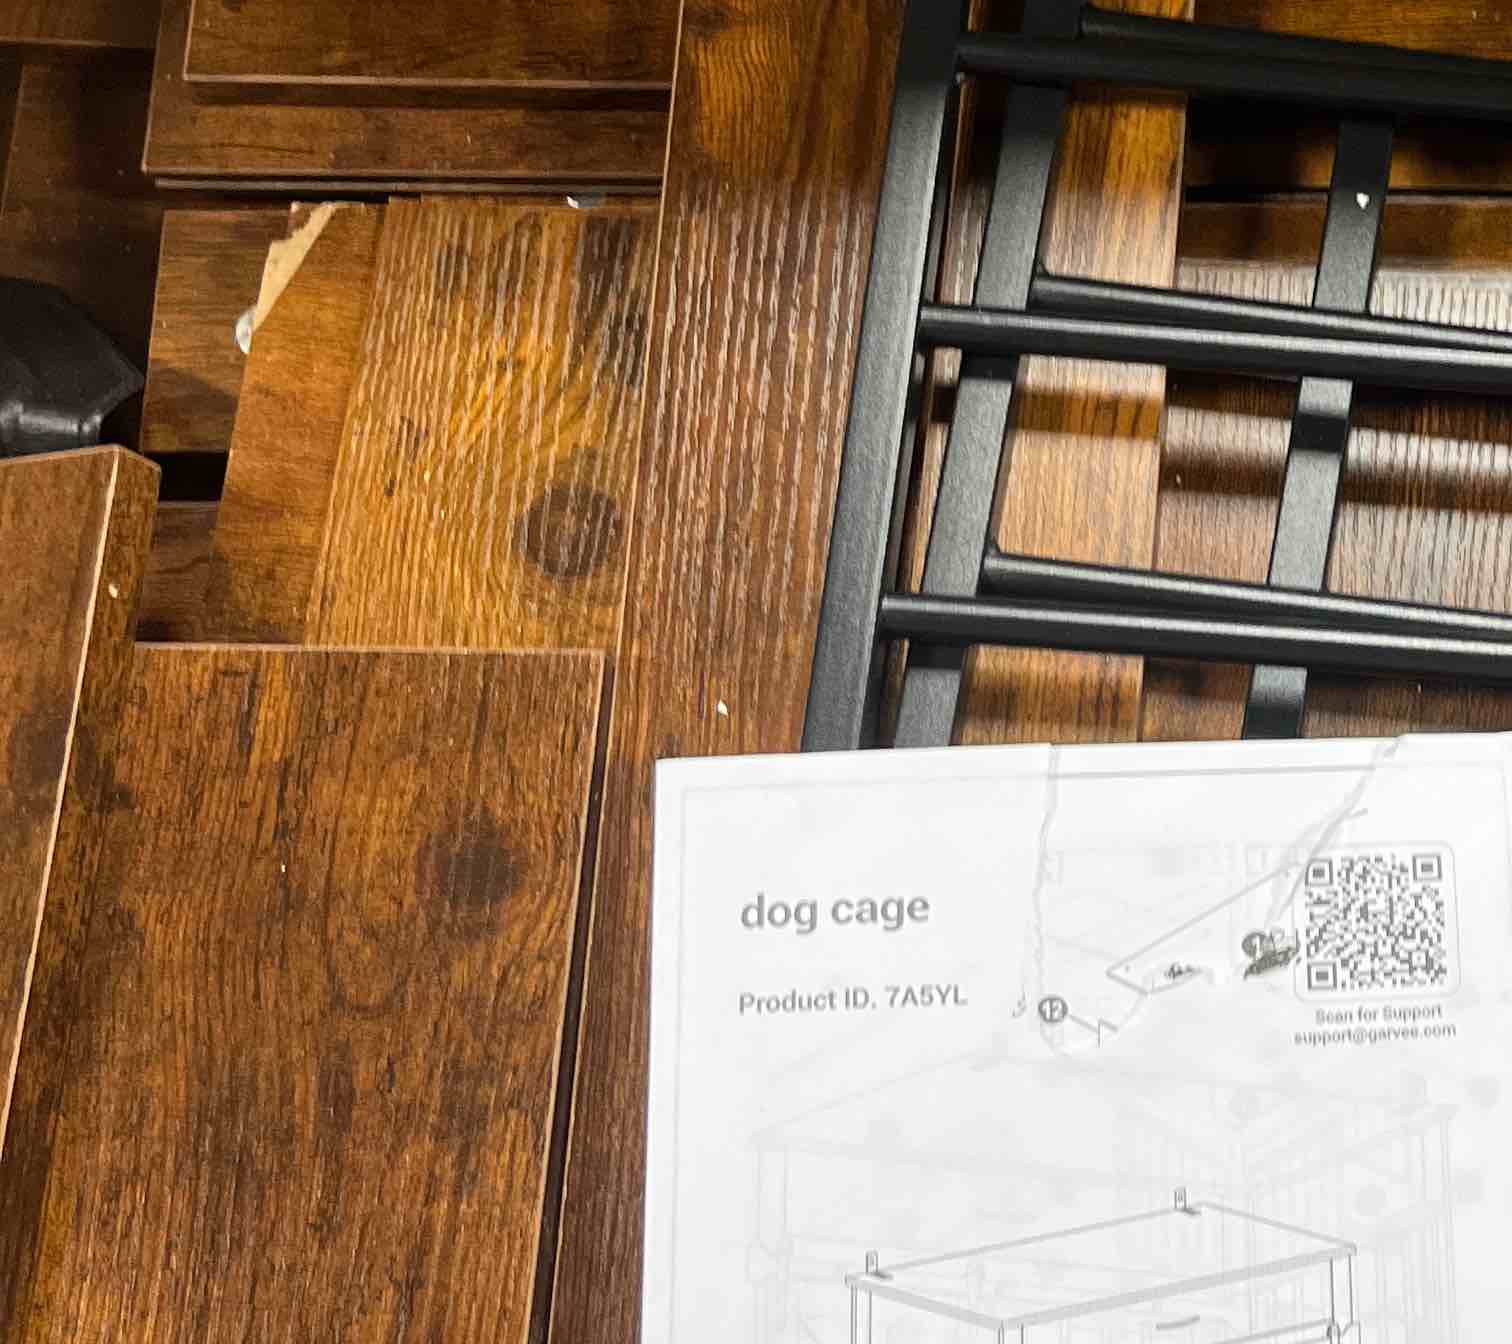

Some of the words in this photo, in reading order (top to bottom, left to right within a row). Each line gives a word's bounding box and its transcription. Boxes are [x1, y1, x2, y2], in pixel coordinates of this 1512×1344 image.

[739, 891, 818, 936] dog
[831, 894, 930, 933] cage
[738, 988, 837, 1016] Product
[884, 983, 969, 1009] 7A5YL
[1315, 1007, 1353, 1026] Scan
[1357, 1005, 1379, 1023] for
[1382, 1003, 1443, 1025] Support
